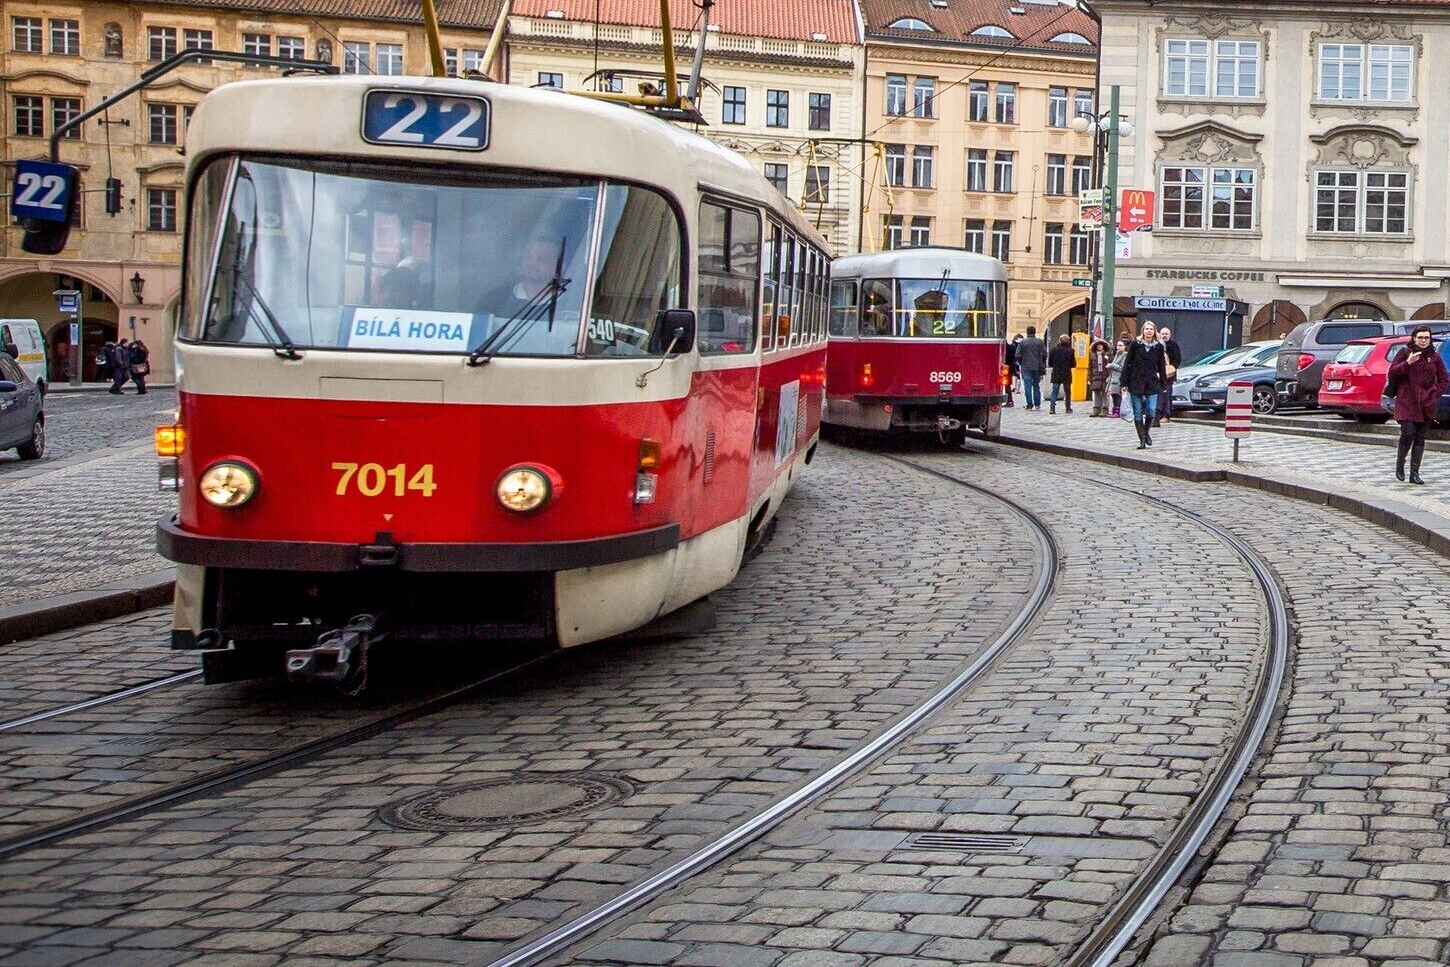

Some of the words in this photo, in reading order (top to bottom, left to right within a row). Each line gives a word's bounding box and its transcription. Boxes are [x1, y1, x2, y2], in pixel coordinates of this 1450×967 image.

[377, 93, 482, 147] 22
[15, 172, 66, 210] 22
[1146, 270, 1218, 280] STARBUCKS
[1220, 272, 1264, 282] COFFEE
[355, 315, 400, 338] BÍLÁ
[408, 322, 464, 340] HORA
[588, 318, 614, 342] 540
[933, 320, 956, 334] 22
[930, 372, 962, 383] 8569
[332, 462, 438, 497] 7014
